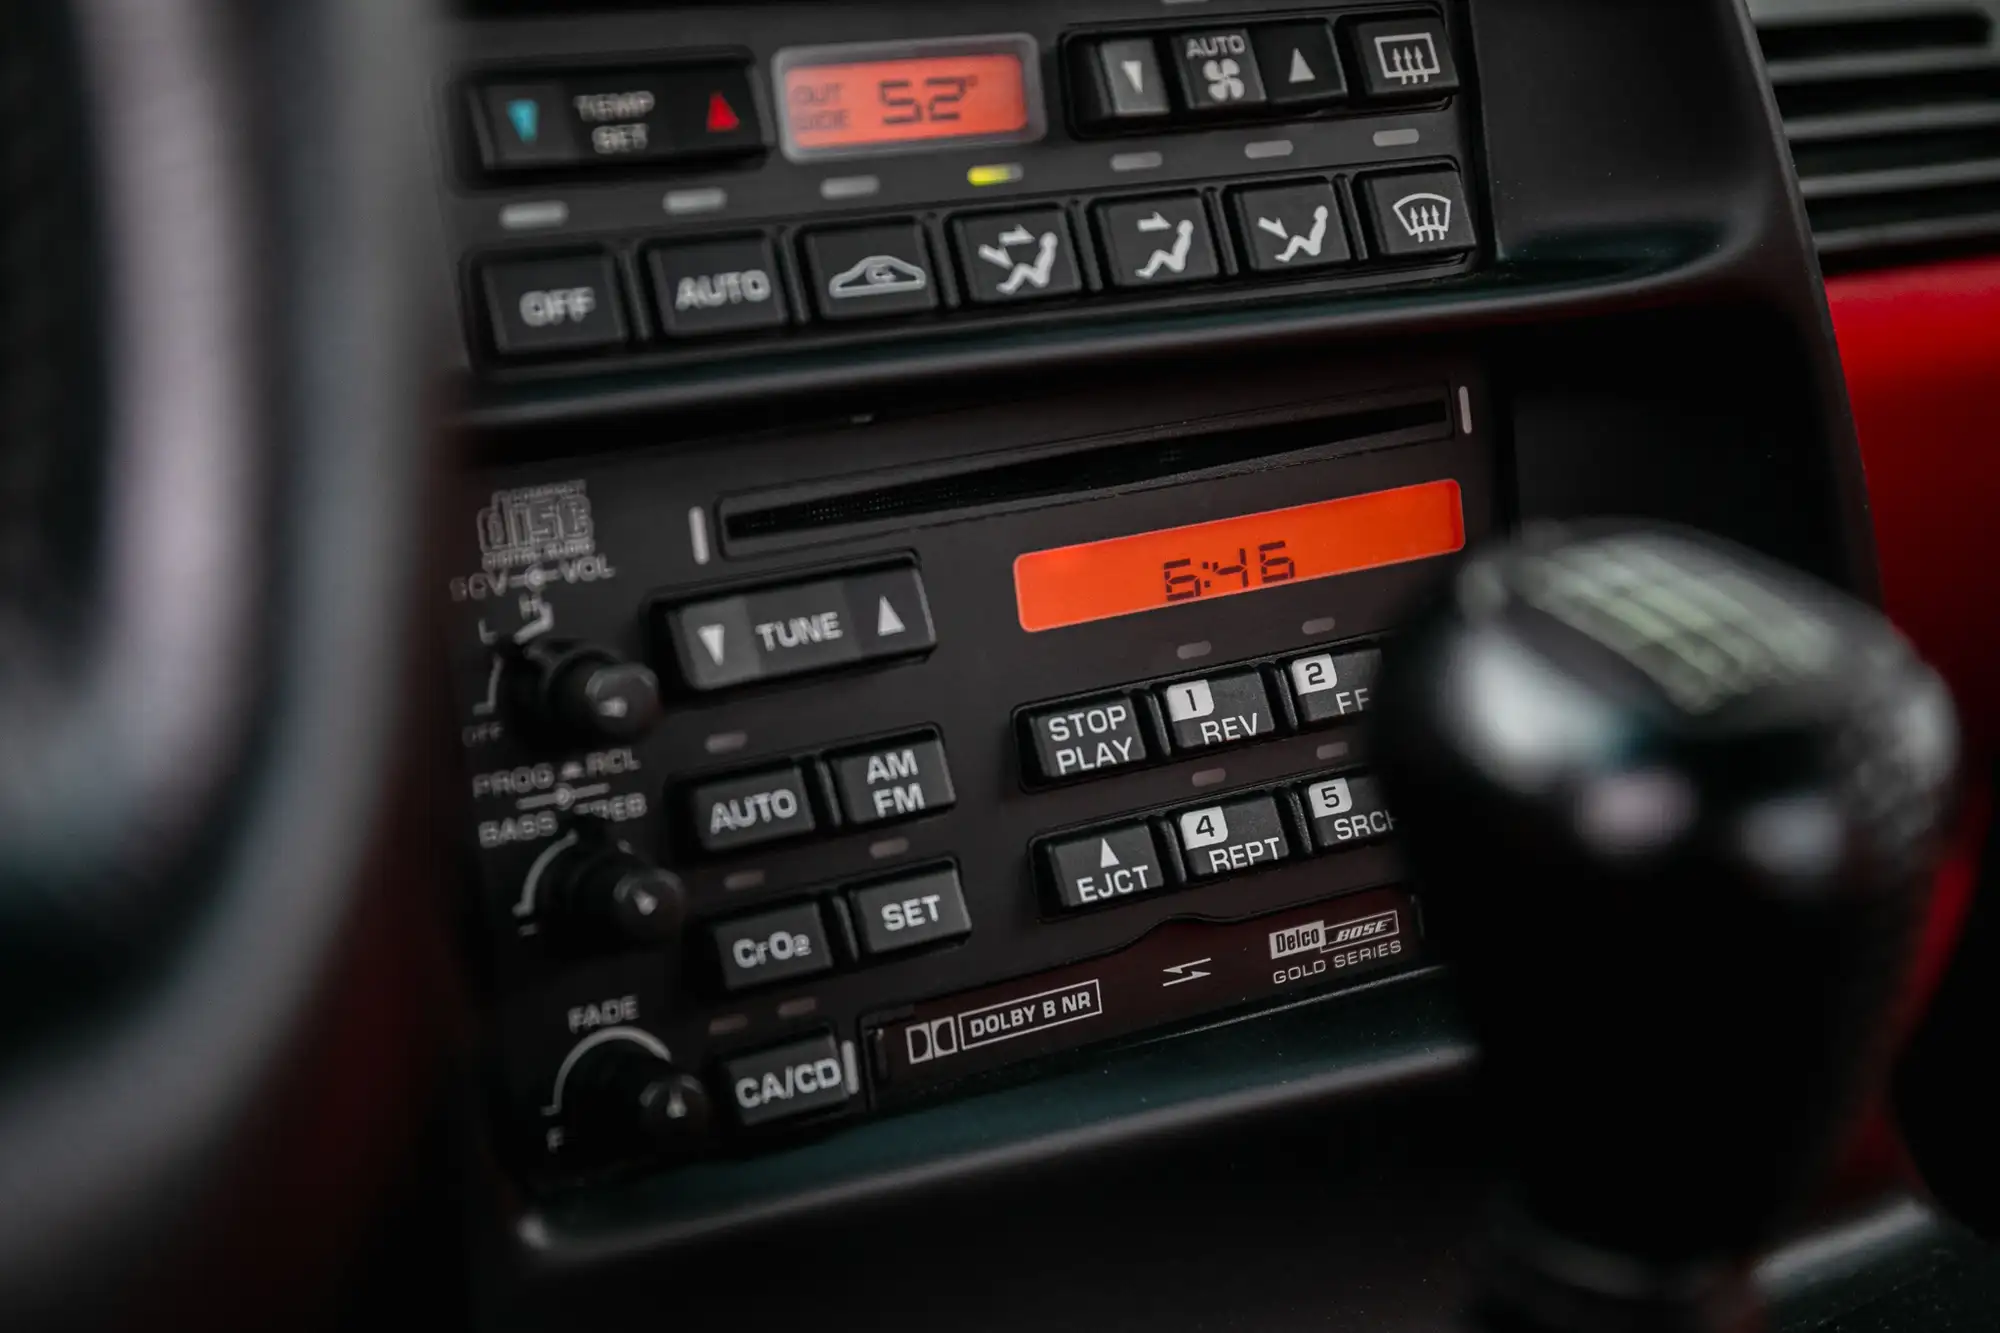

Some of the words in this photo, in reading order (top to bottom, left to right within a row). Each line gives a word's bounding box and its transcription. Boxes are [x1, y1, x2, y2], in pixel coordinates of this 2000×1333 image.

[1186, 33, 1246, 60] AUTO
[519, 286, 596, 327] OFF
[675, 268, 771, 311] AUTO
[559, 553, 616, 583] VOL
[1163, 540, 1295, 601] 6:46
[756, 612, 843, 651] TUNE
[1305, 662, 1326, 686] 2
[1185, 689, 1198, 711] 1
[1335, 688, 1370, 715] FF
[1048, 705, 1127, 742] STOP
[1200, 713, 1259, 745] REV
[473, 762, 555, 798] PROG
[586, 748, 641, 778] RCL
[866, 750, 918, 785] AM
[1056, 737, 1132, 775] PLAY
[710, 789, 798, 833] AUTO
[872, 783, 925, 818] FM
[1321, 786, 1340, 808] 5
[478, 810, 558, 848] BASS
[1195, 814, 1215, 838] 4
[1209, 836, 1280, 873] REPT
[1076, 865, 1149, 902] EJCT
[881, 895, 941, 931] SET
[1275, 928, 1320, 953] Delco
[1331, 919, 1393, 944] BOSE
[1273, 960, 1326, 984] GOLD
[1334, 940, 1402, 968] SERIES
[568, 994, 640, 1034] FADE
[970, 1004, 1036, 1038] DOLBY
[1043, 1000, 1056, 1019] B
[1061, 991, 1092, 1014] NR
[735, 1057, 841, 1108] CA/CD
